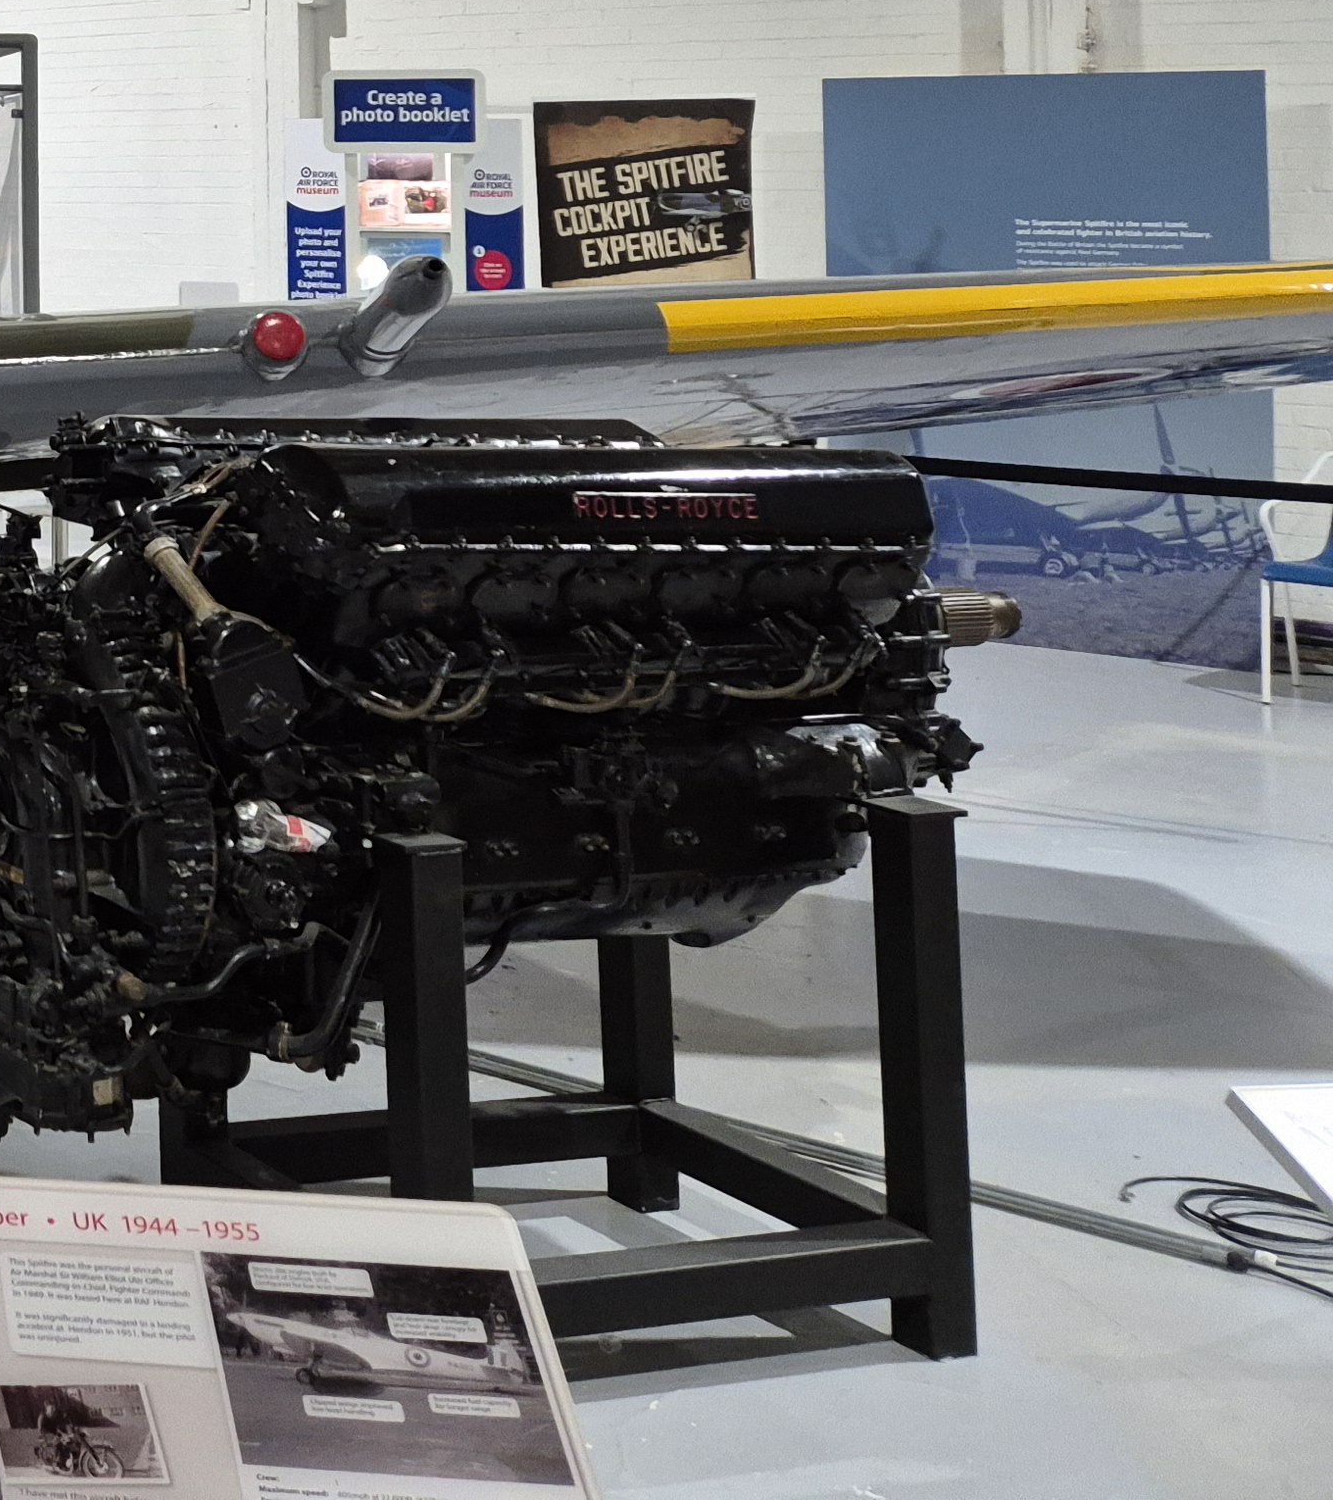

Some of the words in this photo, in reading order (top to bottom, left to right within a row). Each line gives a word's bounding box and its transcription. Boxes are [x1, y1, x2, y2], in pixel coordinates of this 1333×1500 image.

[367, 90, 425, 106] Create
[430, 93, 443, 106] a
[340, 107, 394, 126] photo
[398, 106, 470, 123] booklet
[485, 173, 511, 181] ROYAL
[557, 169, 609, 204] THE
[616, 151, 729, 195] SPITFIRE
[486, 181, 512, 189] FORCE
[296, 187, 339, 195] museum
[469, 190, 514, 198] museum
[553, 198, 651, 237] COCKPIT
[295, 228, 322, 236] Upload
[324, 228, 342, 237] your
[298, 239, 321, 247] photo
[581, 222, 728, 269] EXPERIENCE
[300, 261, 319, 269] your
[303, 270, 334, 279] Spitfire
[297, 280, 341, 290] Experience
[575, 495, 758, 519] ROLLS-ROYCE
[73, 1210, 108, 1232] UK
[121, 1214, 181, 1236] 1944
